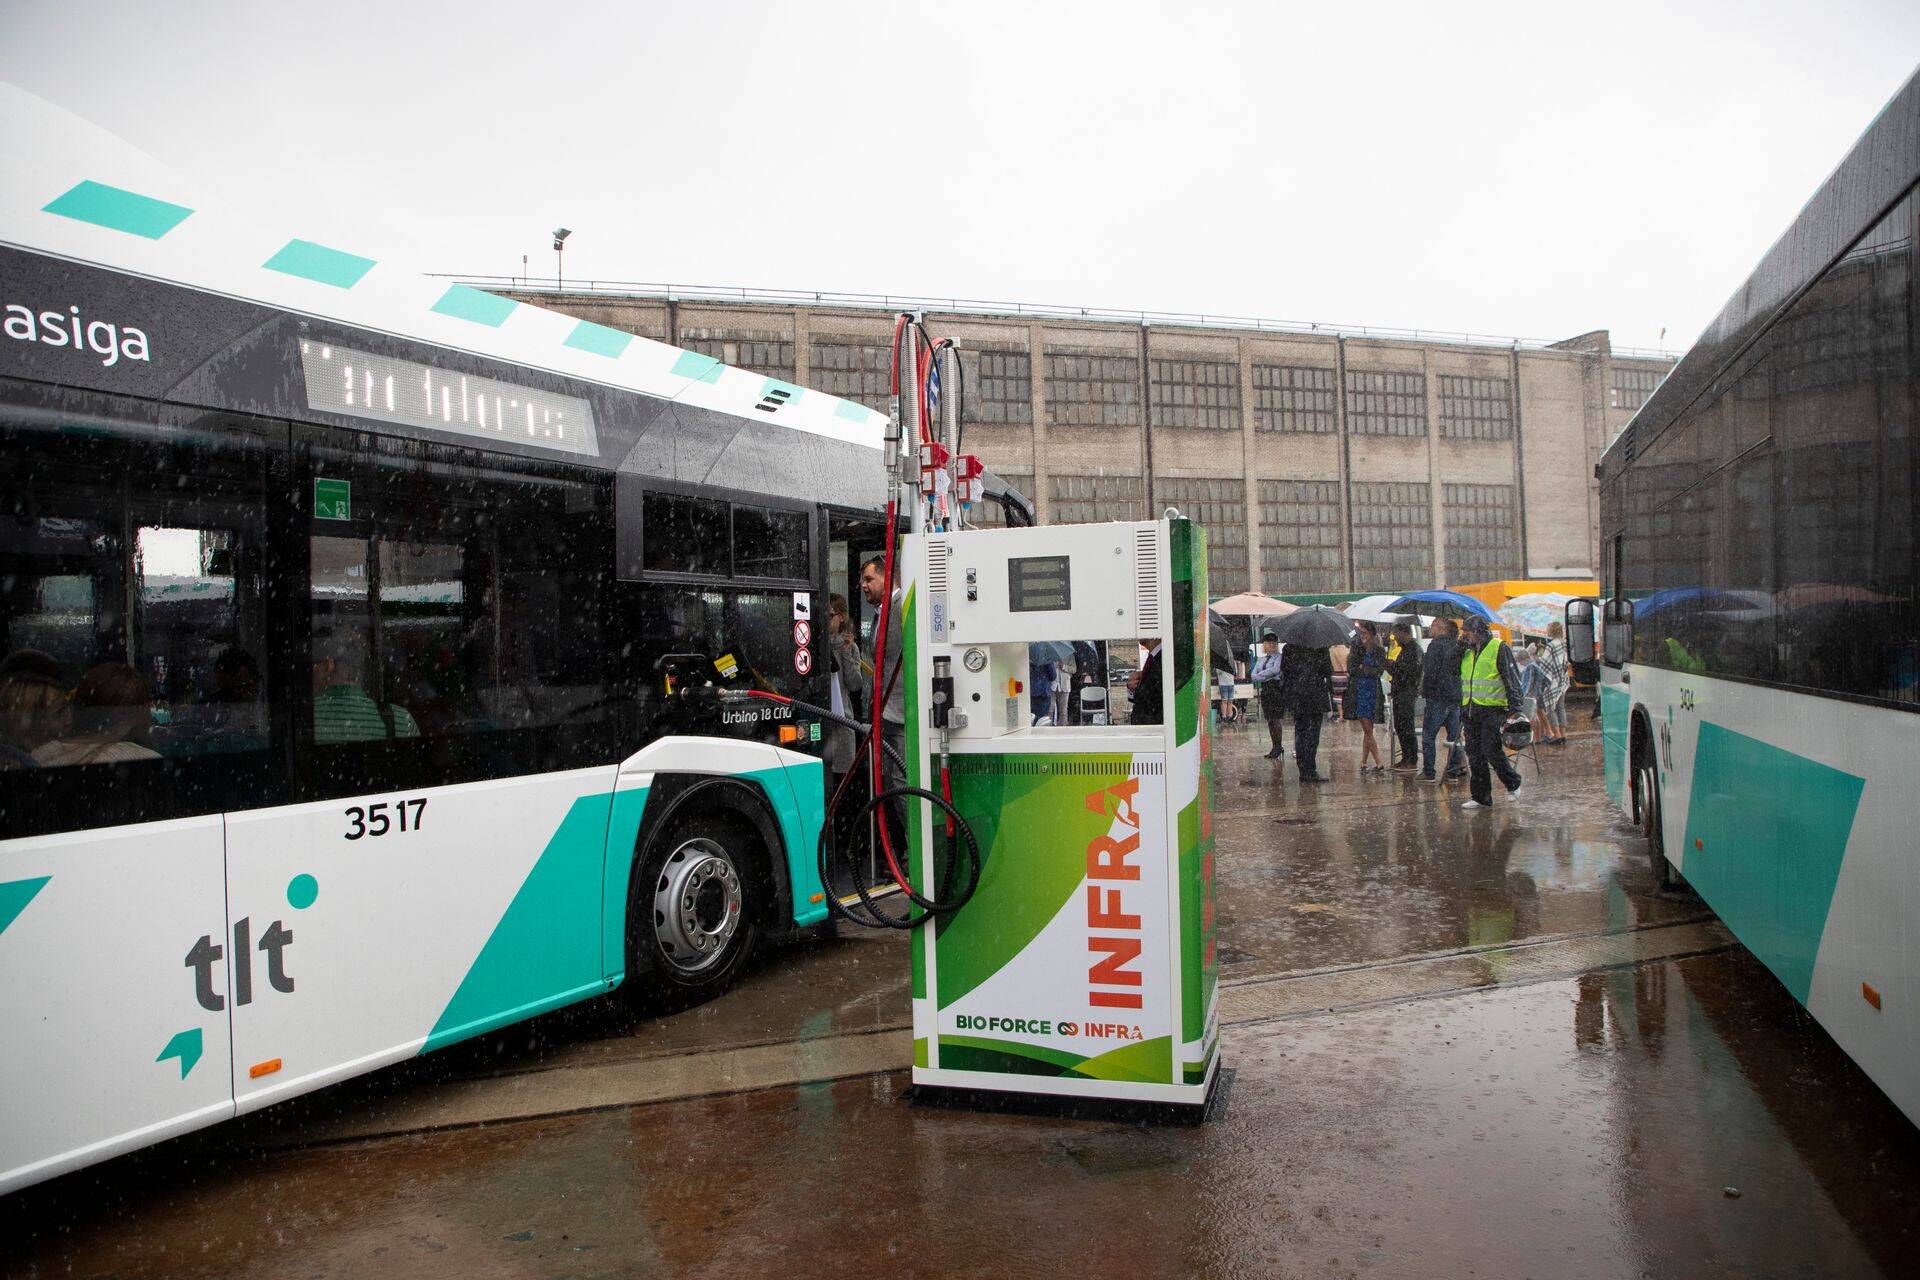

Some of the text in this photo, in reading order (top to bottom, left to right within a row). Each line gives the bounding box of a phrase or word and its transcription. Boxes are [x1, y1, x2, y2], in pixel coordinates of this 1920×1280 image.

[3, 304, 150, 367] asiga
[934, 604, 943, 632] safe
[722, 709, 758, 724] Urbino
[760, 708, 772, 720] 18
[1680, 687, 1694, 712] 3424
[344, 798, 428, 841] 3517
[1085, 776, 1143, 1009] INFRA
[184, 916, 295, 1012] tlt
[956, 1014, 1144, 1040] BIOFORCE INFRA
